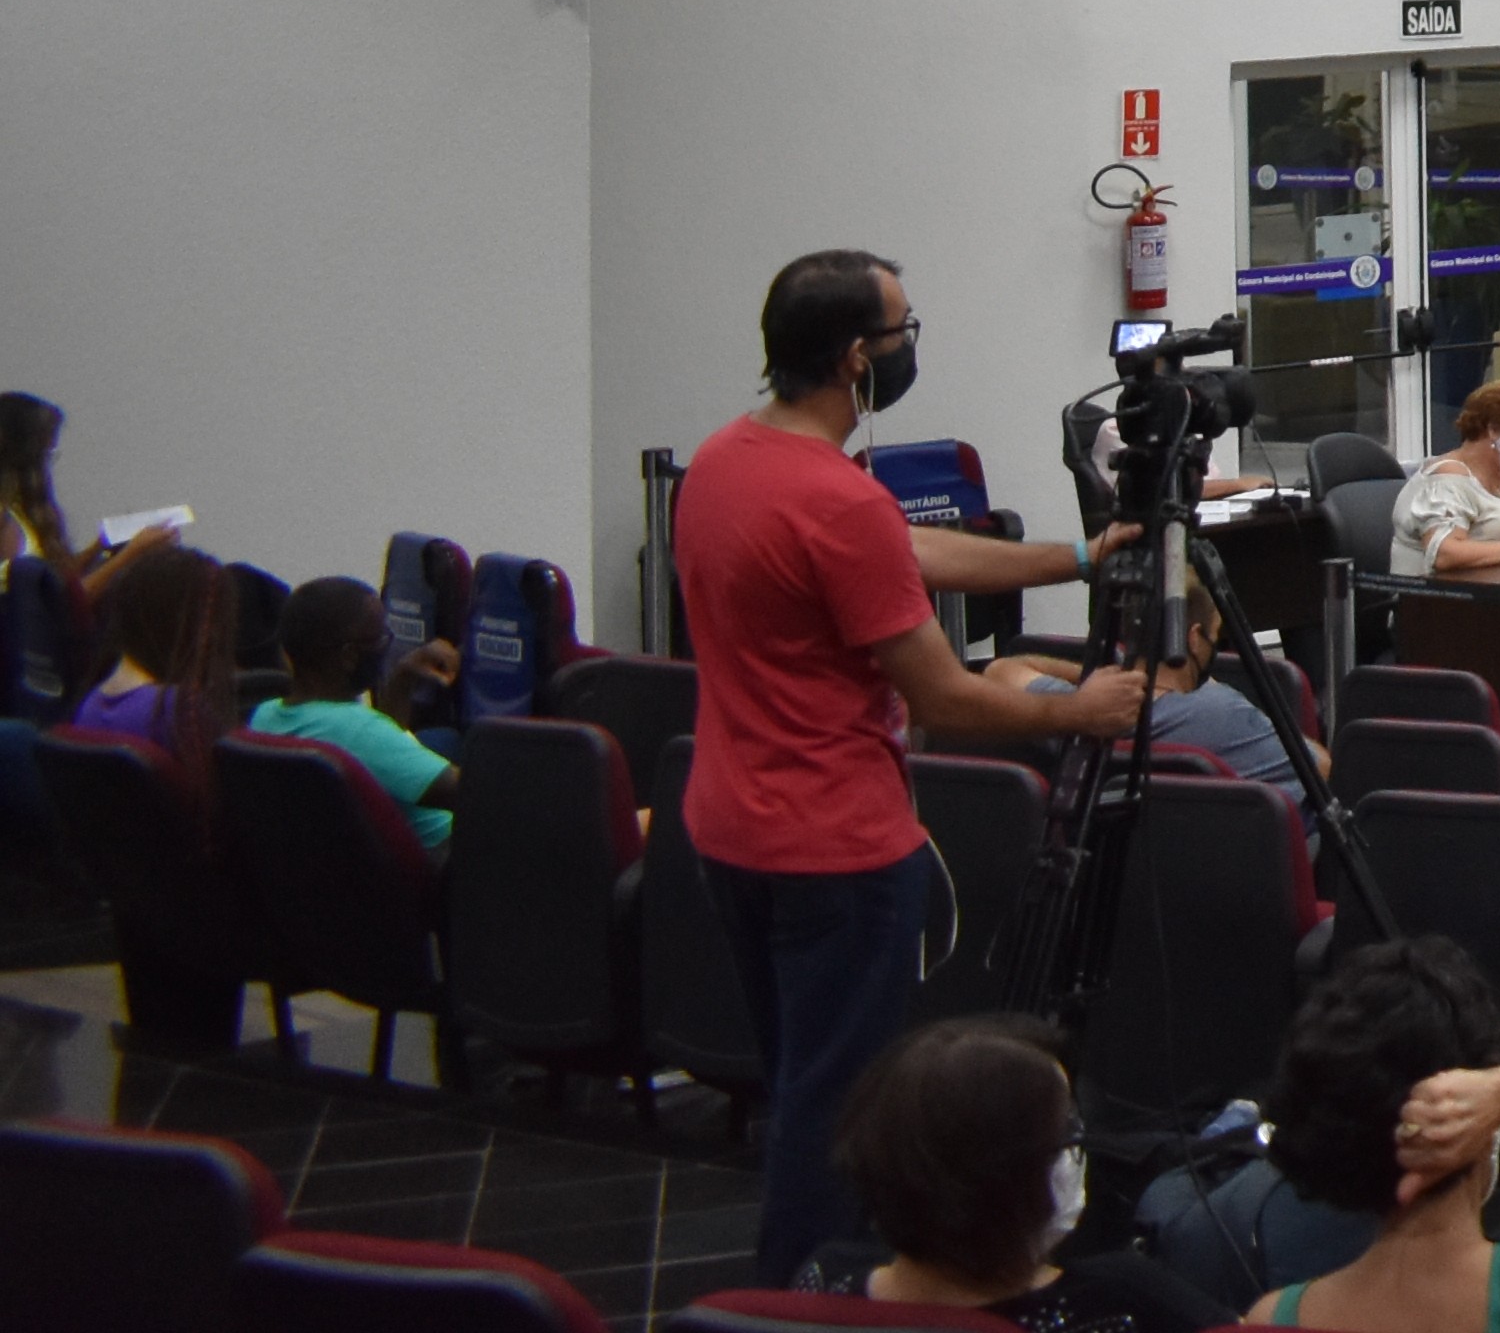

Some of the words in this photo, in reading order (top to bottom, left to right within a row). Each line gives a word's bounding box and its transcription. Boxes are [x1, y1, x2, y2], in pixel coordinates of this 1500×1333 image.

[1407, 1, 1456, 33] SAÍDA
[1456, 255, 1485, 265] Municipal
[1264, 274, 1294, 285] Municipal
